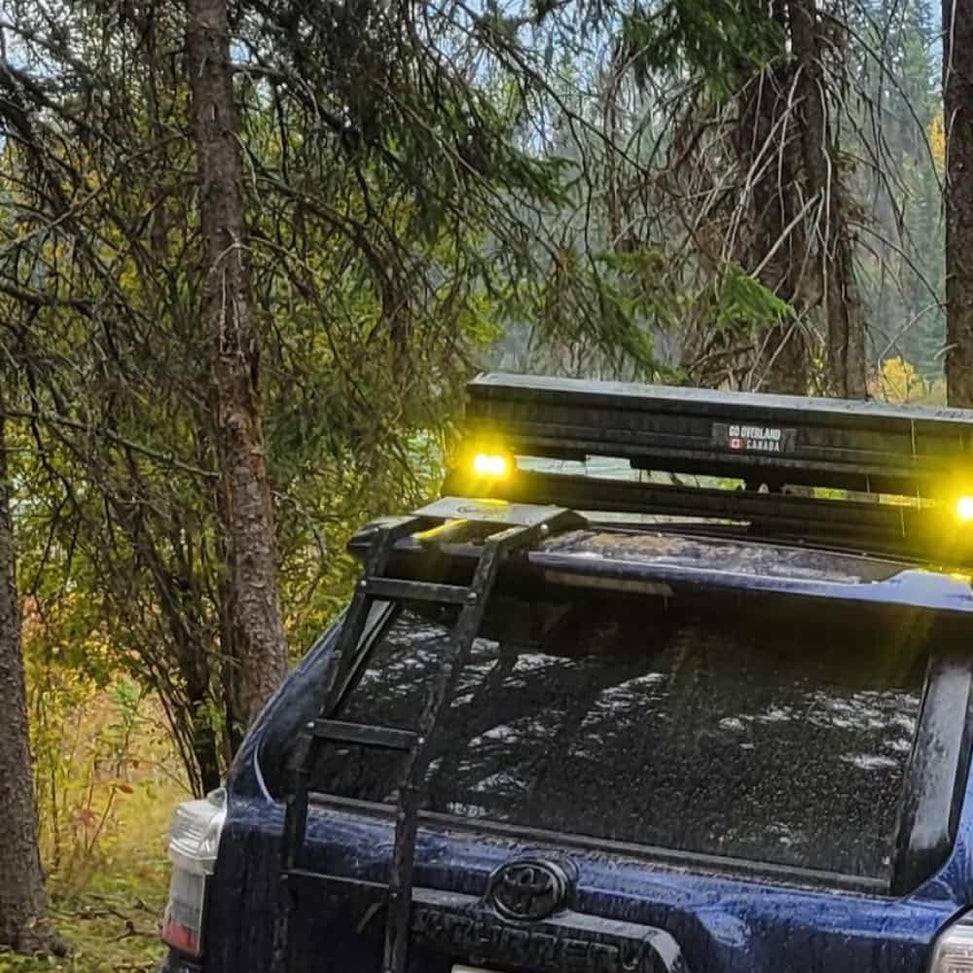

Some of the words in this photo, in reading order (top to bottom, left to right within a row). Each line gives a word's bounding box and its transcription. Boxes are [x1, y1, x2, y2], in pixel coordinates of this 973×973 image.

[728, 425, 740, 437] GO
[741, 425, 781, 440] OVERLAND
[746, 439, 780, 452] CANADA
